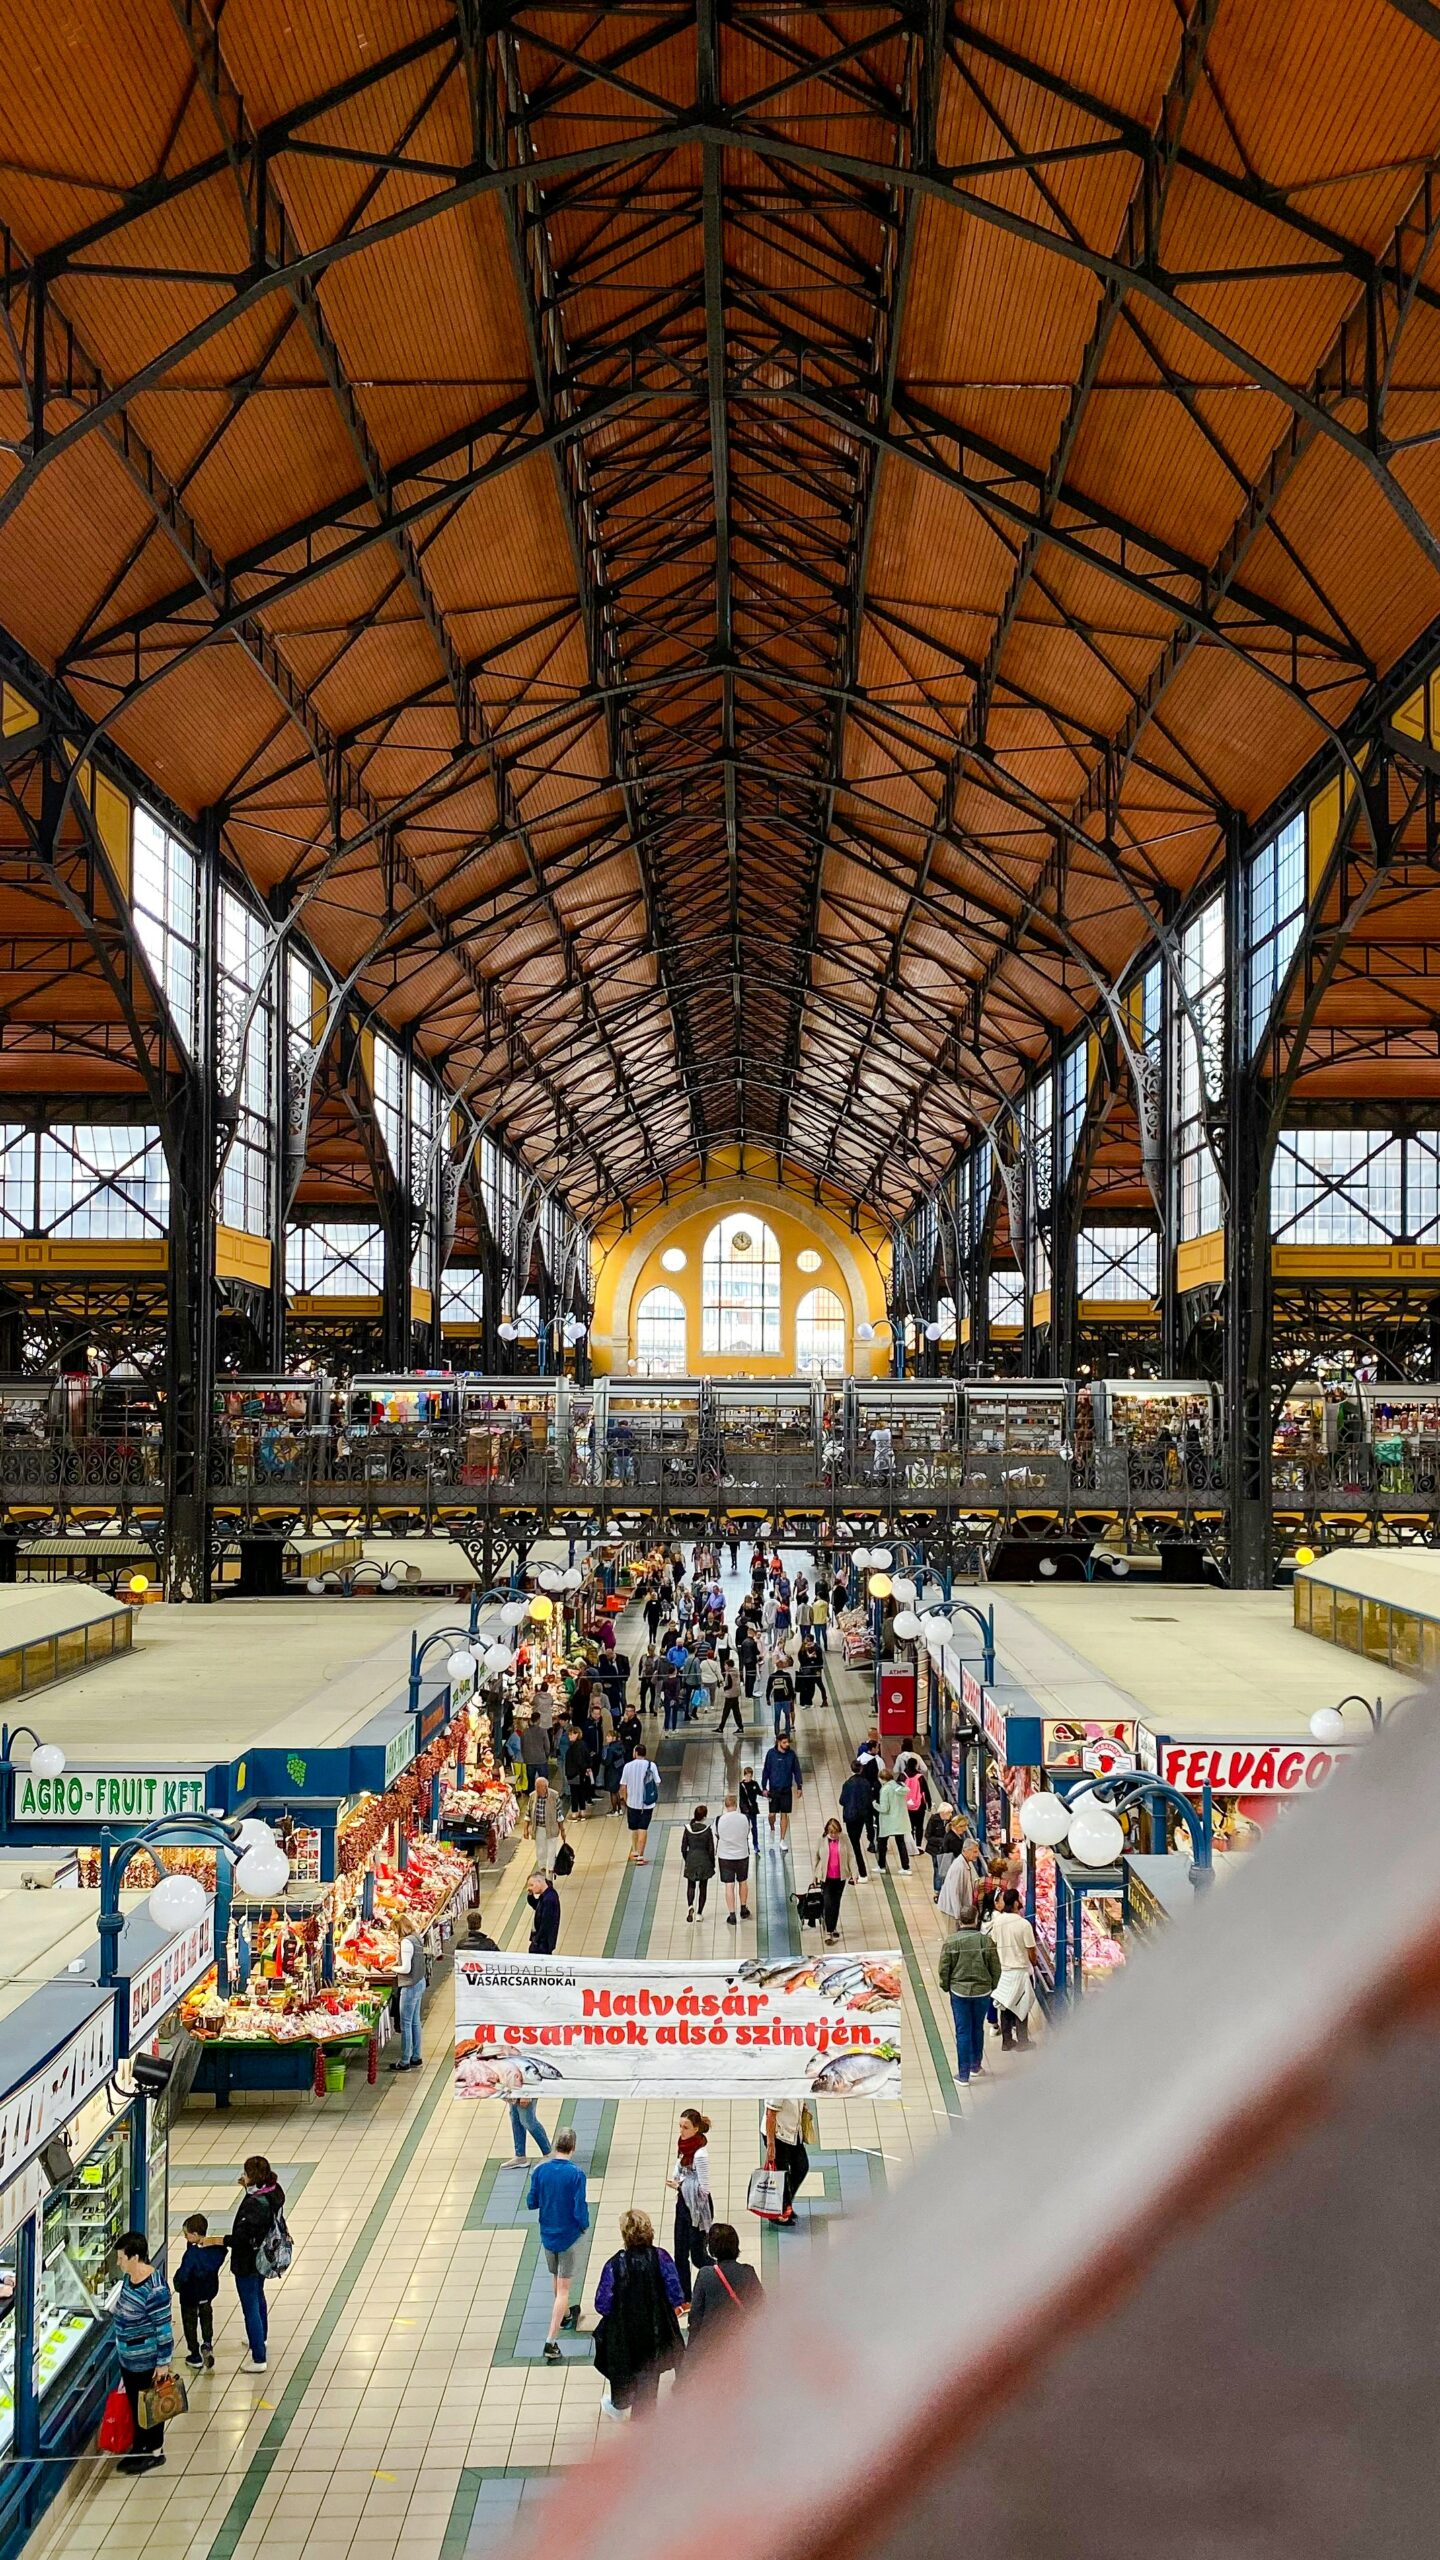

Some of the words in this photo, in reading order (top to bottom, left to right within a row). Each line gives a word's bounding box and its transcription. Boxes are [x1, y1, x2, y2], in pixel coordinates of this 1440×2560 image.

[20, 1776, 157, 1815] AGRO-FRUIT
[162, 1780, 205, 1815] KFT.
[485, 1963, 576, 1977] BUDAPEST
[581, 1985, 769, 2018] Halvásár
[474, 2023, 497, 2044] a
[503, 2020, 649, 2046] csarnok
[655, 2016, 728, 2046] alsó
[735, 2016, 881, 2053] szintjén.
